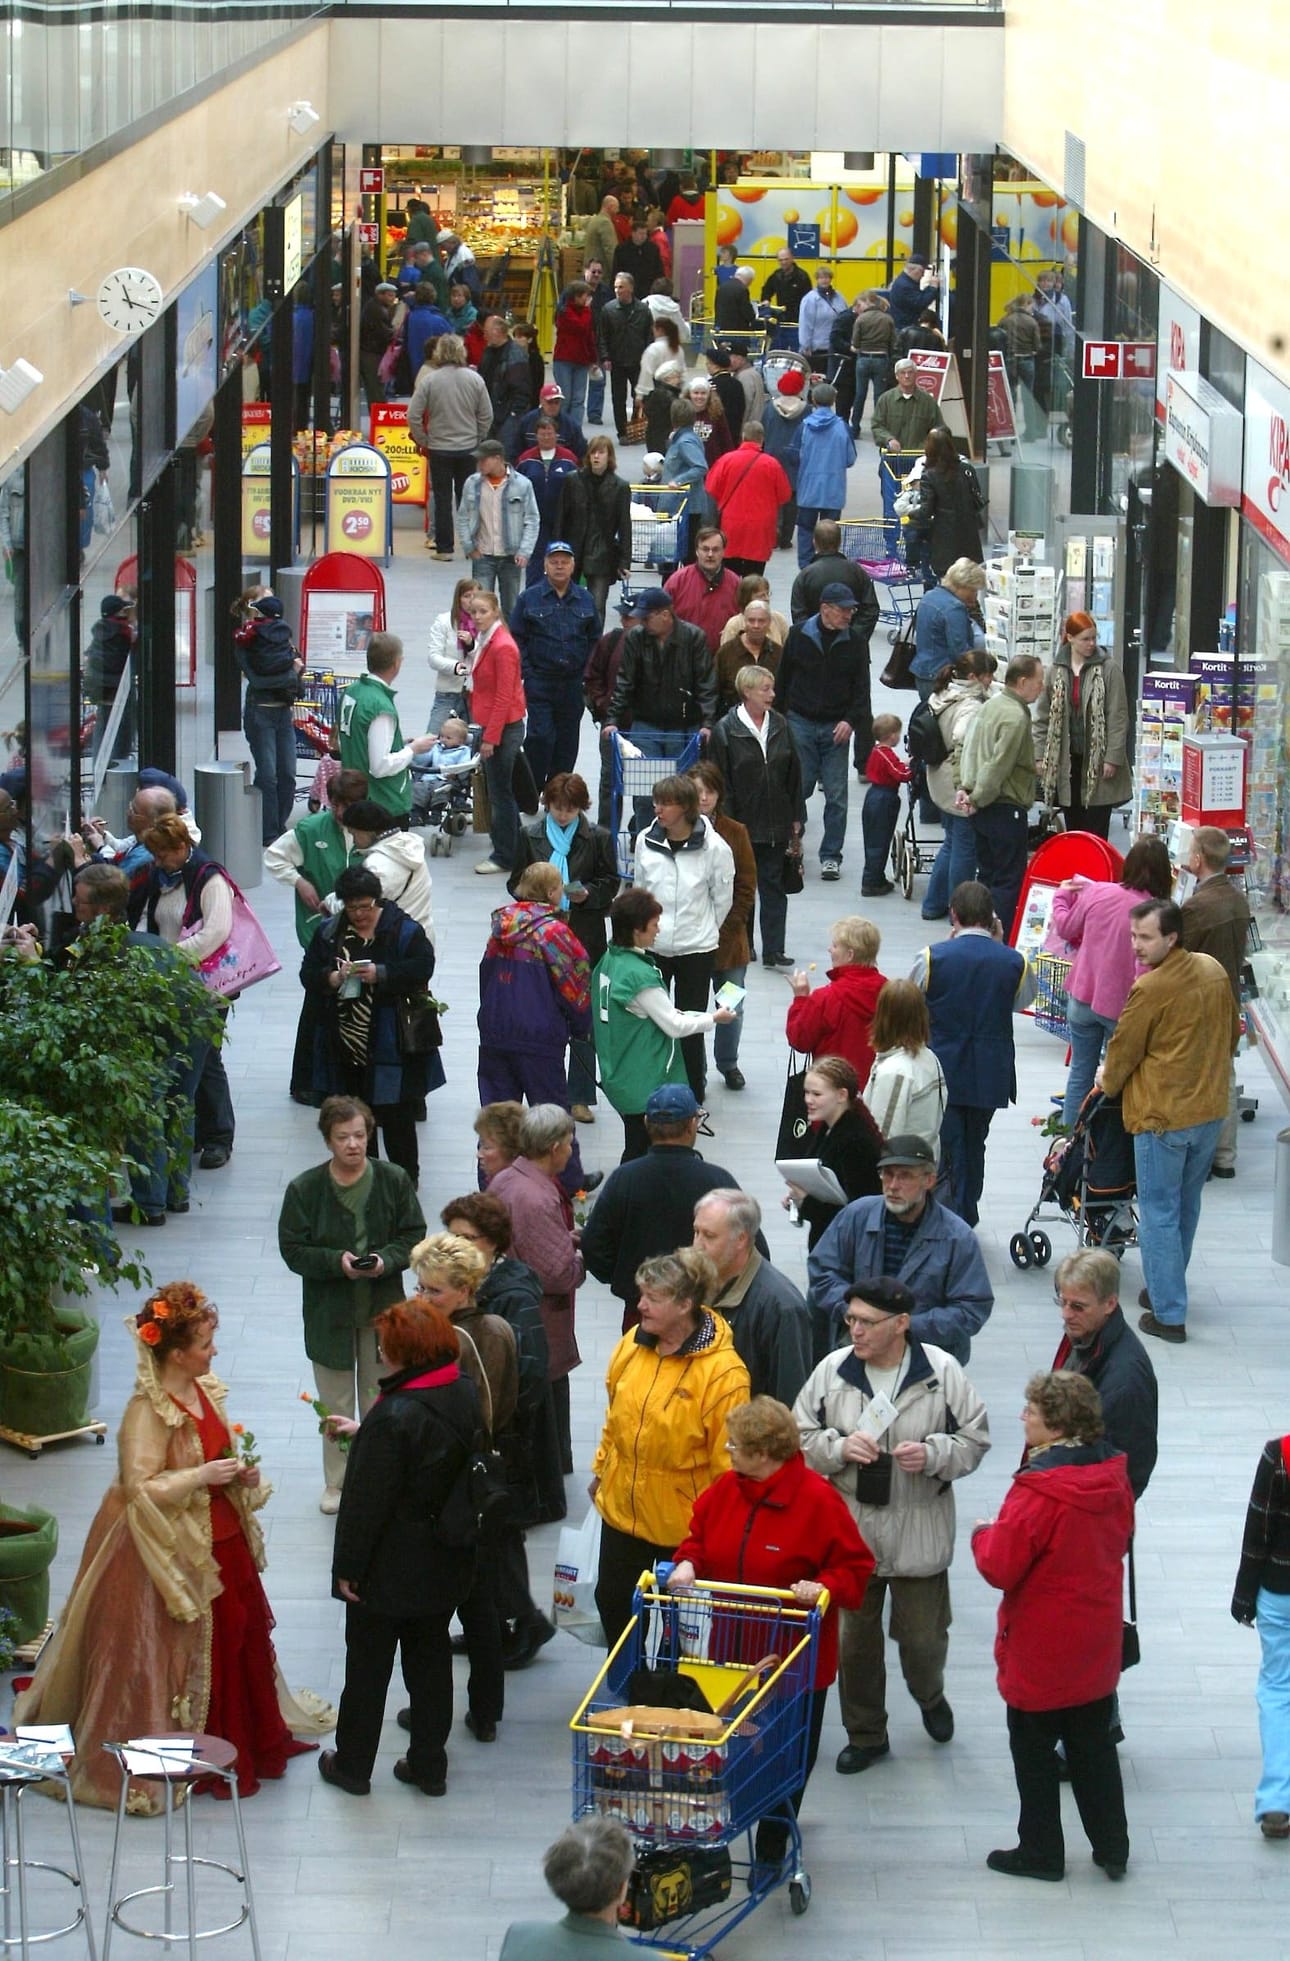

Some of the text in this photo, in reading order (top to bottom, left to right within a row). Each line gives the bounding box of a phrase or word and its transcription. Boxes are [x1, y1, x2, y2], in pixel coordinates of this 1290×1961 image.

[1171, 320, 1186, 371] KIPA
[1269, 410, 1290, 483] KIPA
[345, 517, 357, 533] 2
[1201, 662, 1227, 671] Kortit
[1155, 680, 1180, 690] Kortit
